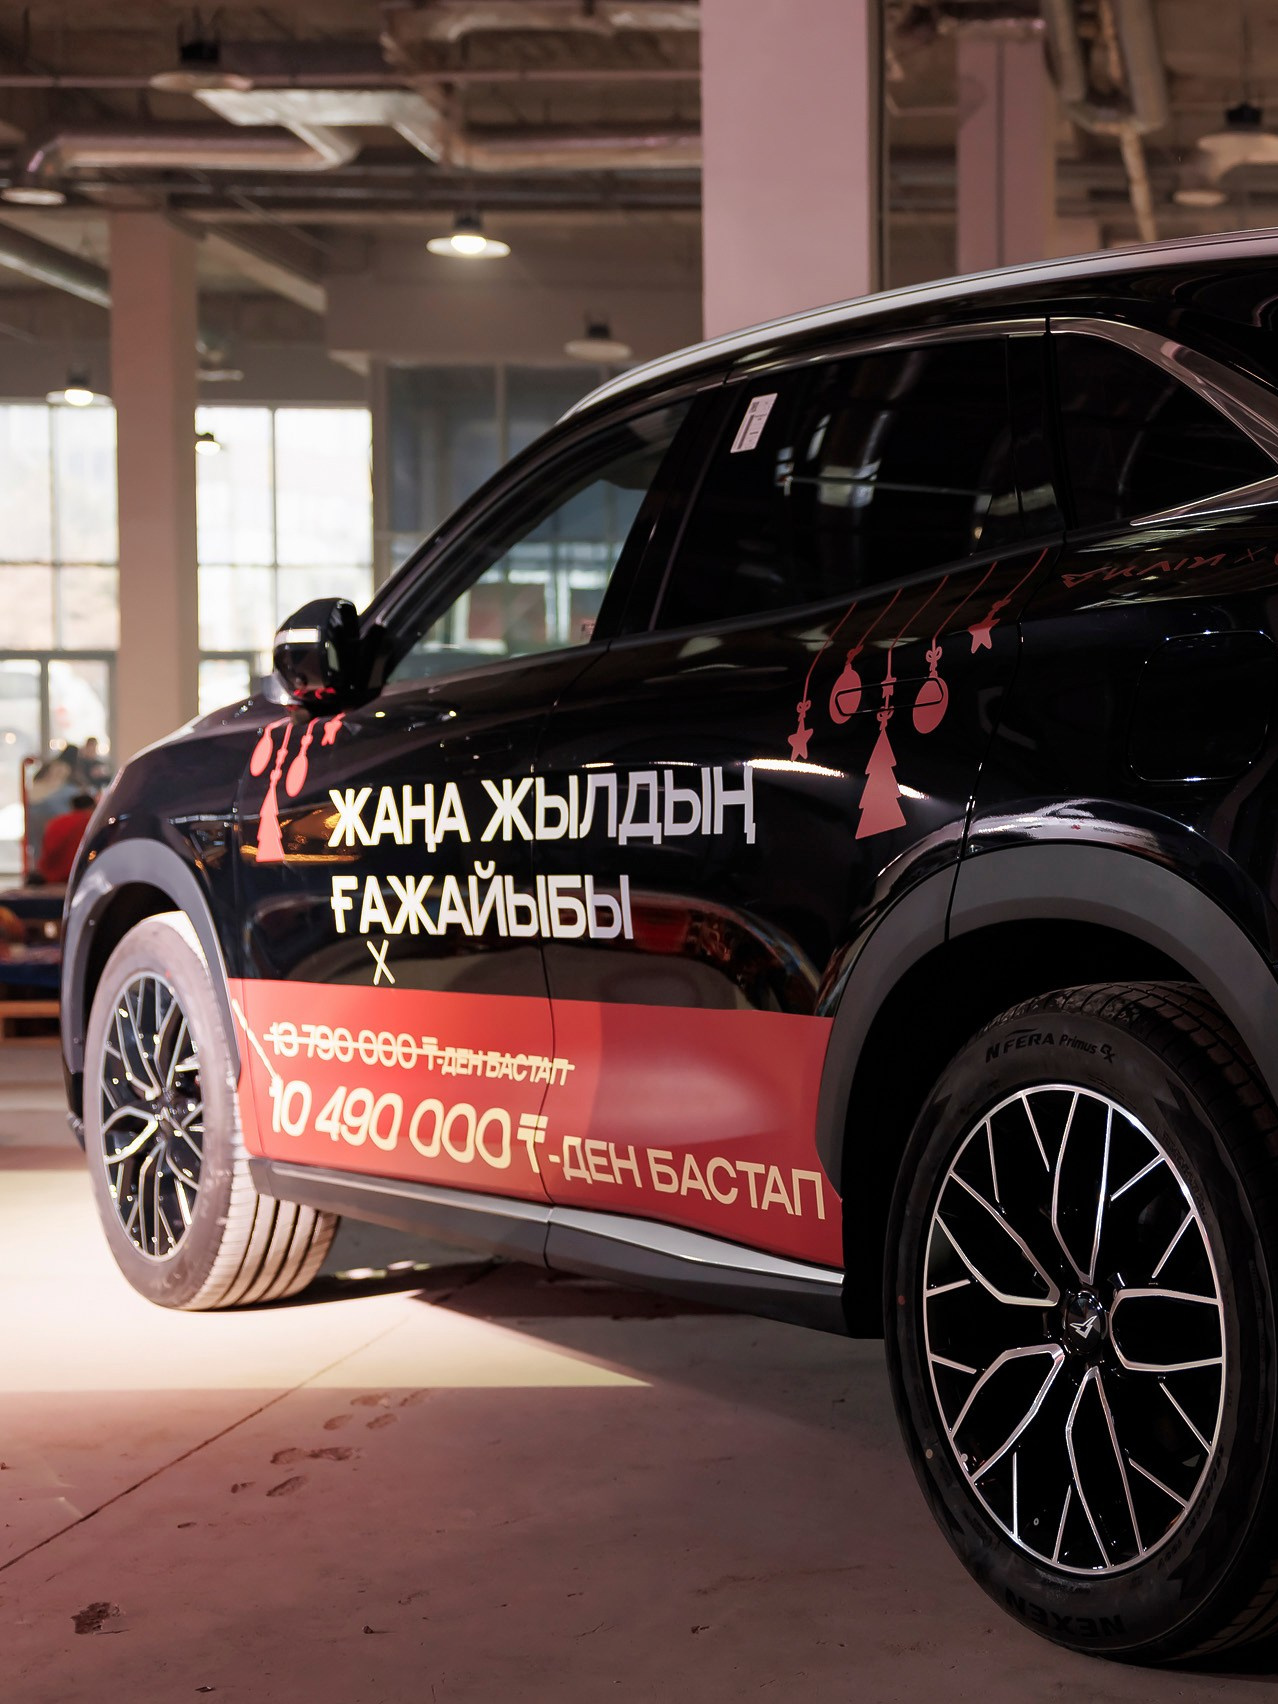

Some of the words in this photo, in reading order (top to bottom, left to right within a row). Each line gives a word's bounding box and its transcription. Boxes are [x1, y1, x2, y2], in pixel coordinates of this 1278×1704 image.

[328, 782, 472, 853] ЖАҢА
[480, 766, 757, 845] ЖЫЛДЫҢ
[330, 860, 634, 940] ҒАЖАЙЫБЫ
[301, 1024, 355, 1063] 790
[358, 1029, 418, 1070] 000
[1059, 1033, 1098, 1055] Primus
[268, 1074, 313, 1138] 10
[315, 1085, 404, 1151] 490
[409, 1098, 512, 1169] 000
[647, 1147, 827, 1220] БАСТАП
[1004, 1587, 1128, 1638] NEXEN
